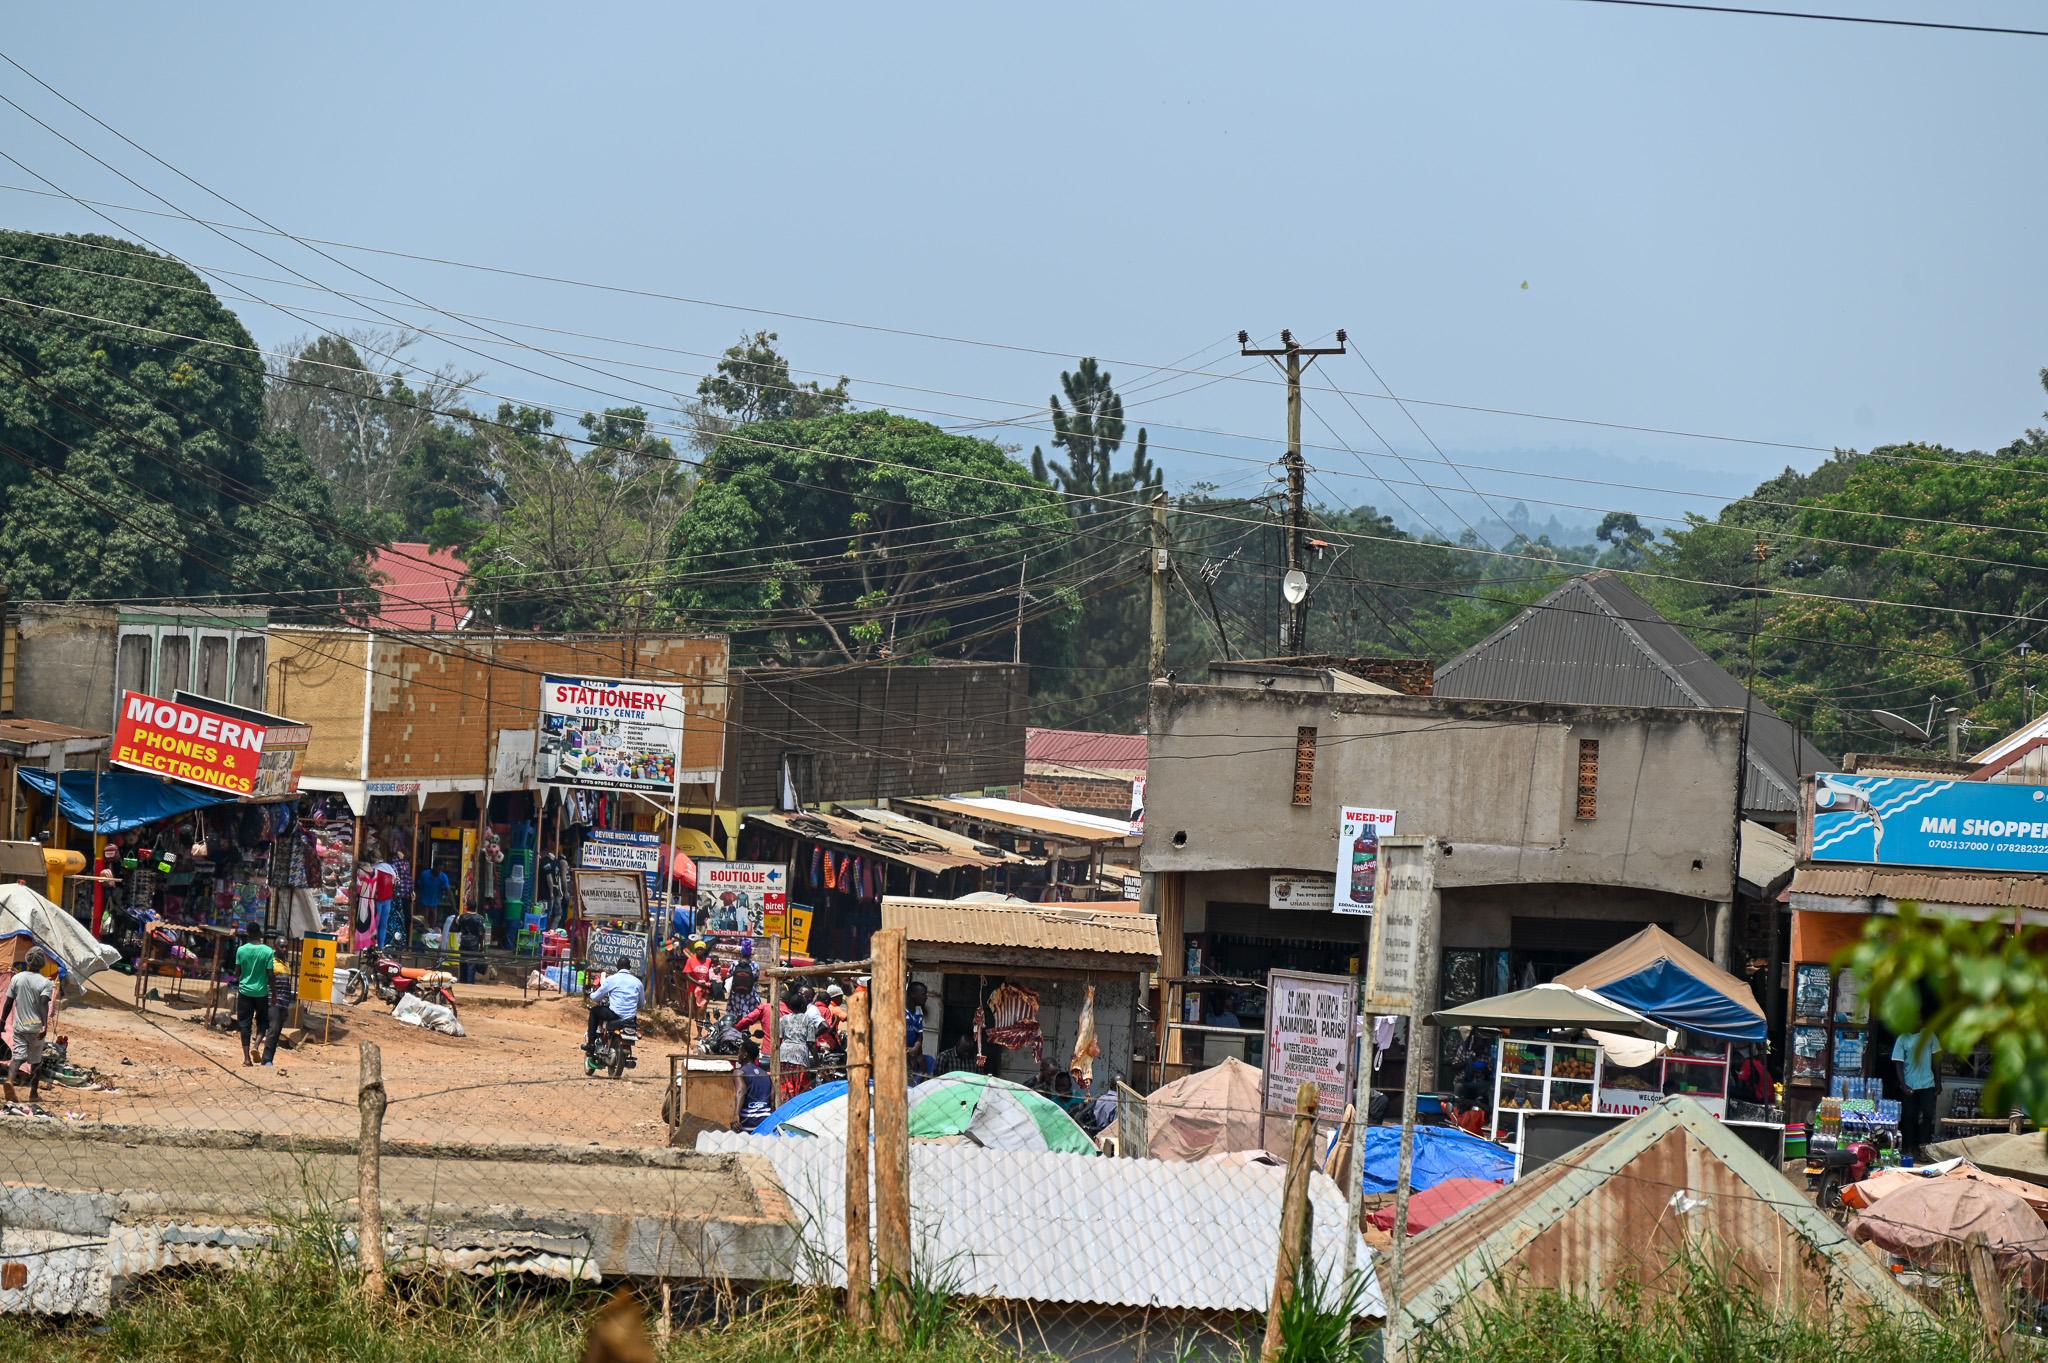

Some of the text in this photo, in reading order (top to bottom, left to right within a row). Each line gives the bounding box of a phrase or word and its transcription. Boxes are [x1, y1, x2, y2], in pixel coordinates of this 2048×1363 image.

[556, 686, 667, 711] STATIONERY
[583, 706, 610, 717] GIFTS
[614, 708, 646, 720] CENTRE
[126, 697, 265, 753] MODERN
[133, 728, 237, 768] PHONES &
[118, 745, 250, 792] ELECTRONICS
[1346, 811, 1393, 823] WEED-UP
[1920, 816, 1957, 834] MM
[595, 830, 660, 843] DEVINE MEDICAL CENTRE
[584, 843, 658, 861] DEVINE MEDICAL CENTRE
[1928, 839, 1989, 851] 0705137000
[599, 857, 648, 870] NAMAYUMBA
[710, 870, 766, 883] BOUTIQUE
[580, 889, 622, 899] NAMAYUMBA
[765, 902, 784, 910] airtel
[593, 943, 643, 958] GUEST HOUSE
[1316, 994, 1339, 1020] CHURCH
[1279, 1015, 1346, 1040] NAMAYUMBA PARISH
[1311, 1056, 1329, 1067] DIOCESE
